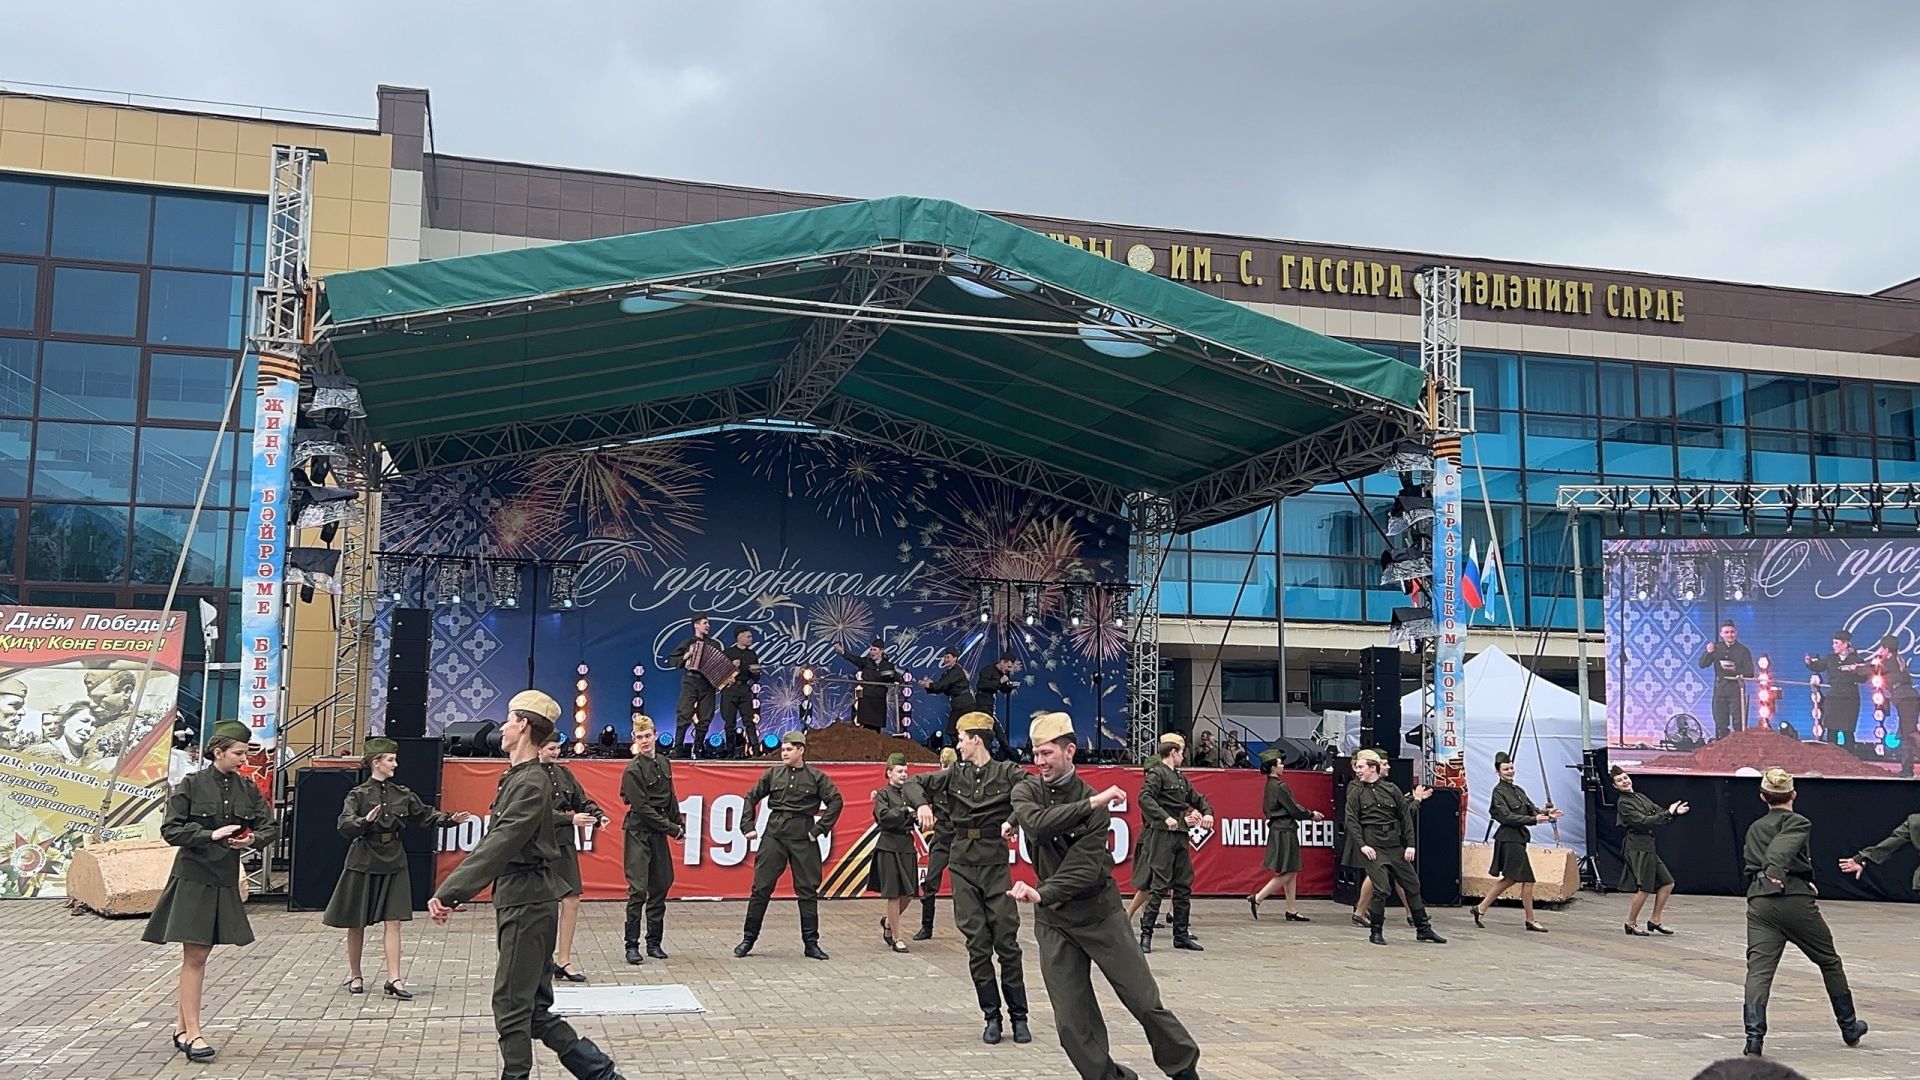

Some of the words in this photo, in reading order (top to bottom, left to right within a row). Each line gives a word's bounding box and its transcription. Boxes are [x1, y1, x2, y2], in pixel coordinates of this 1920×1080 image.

[1171, 244, 1222, 282] ИМ.
[1240, 251, 1264, 286] С.
[1282, 254, 1404, 299] ГАССАРА
[1606, 284, 1685, 322] САРАЕ
[1444, 474, 1455, 486] С
[256, 489, 276, 614] БӘЙРӘМЕ
[1443, 503, 1457, 644] ПРАЗДНИКОМ
[629, 557, 925, 612] праздником!
[5, 611, 75, 632] Днём
[250, 639, 269, 728] БЕЛӘН
[1442, 661, 1457, 748] ПОБЕДЫ
[27, 759, 100, 787] гордимся,
